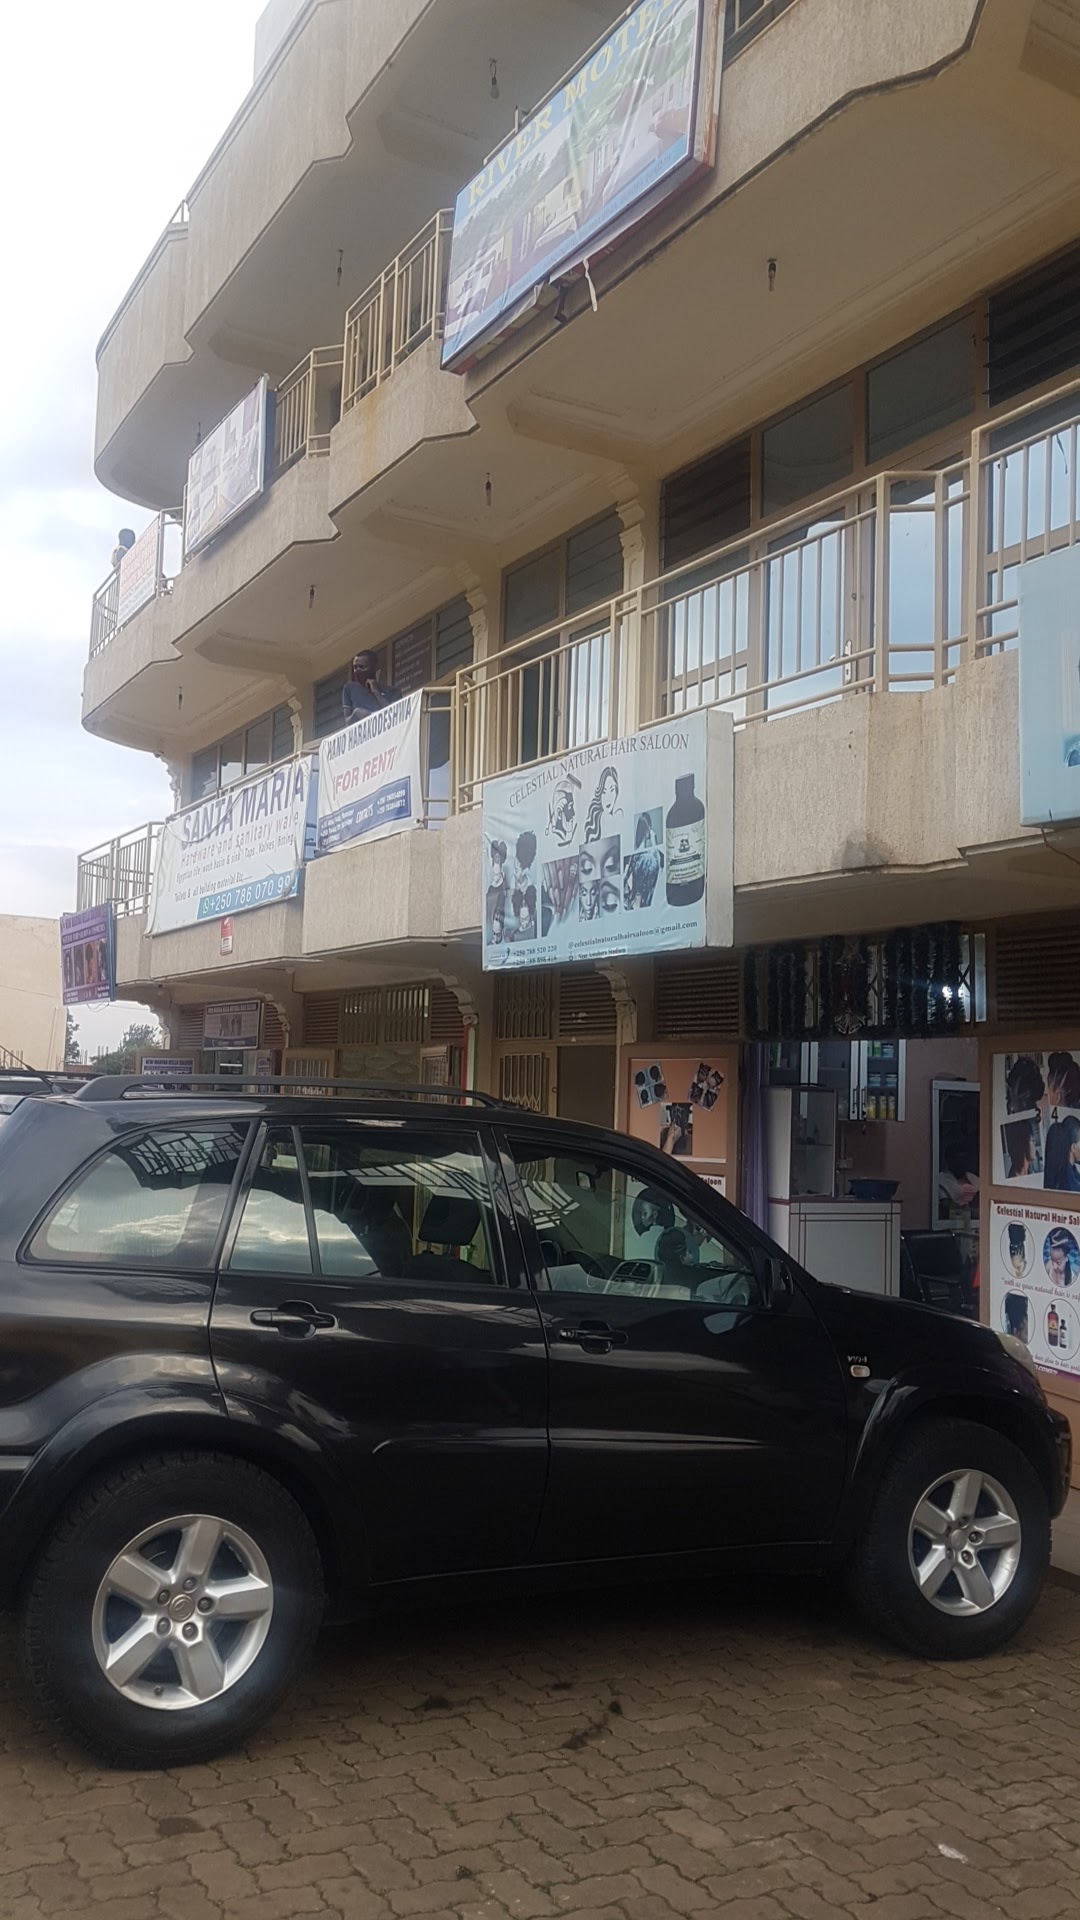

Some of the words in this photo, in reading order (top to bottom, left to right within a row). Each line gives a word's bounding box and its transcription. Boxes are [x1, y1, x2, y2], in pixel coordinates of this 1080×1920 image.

[468, 106, 553, 206] RIVER
[563, 0, 673, 113] MOTE
[335, 766, 359, 795] FOR
[509, 767, 560, 807] CELESTIAL
[561, 744, 608, 775] NATURAL
[610, 737, 637, 755] HAIR
[640, 733, 689, 750] SALOON
[182, 795, 233, 850] SANTA
[240, 768, 304, 827] MARIA
[210, 894, 231, 913] +250
[235, 889, 251, 908] 786
[255, 880, 273, 900] 070
[1051, 1106, 1059, 1123] 4
[997, 1206, 1023, 1218] Celestial
[1025, 1209, 1050, 1222] Natural
[1051, 1212, 1067, 1224] Hair
[1068, 1215, 1080, 1226] Sal
